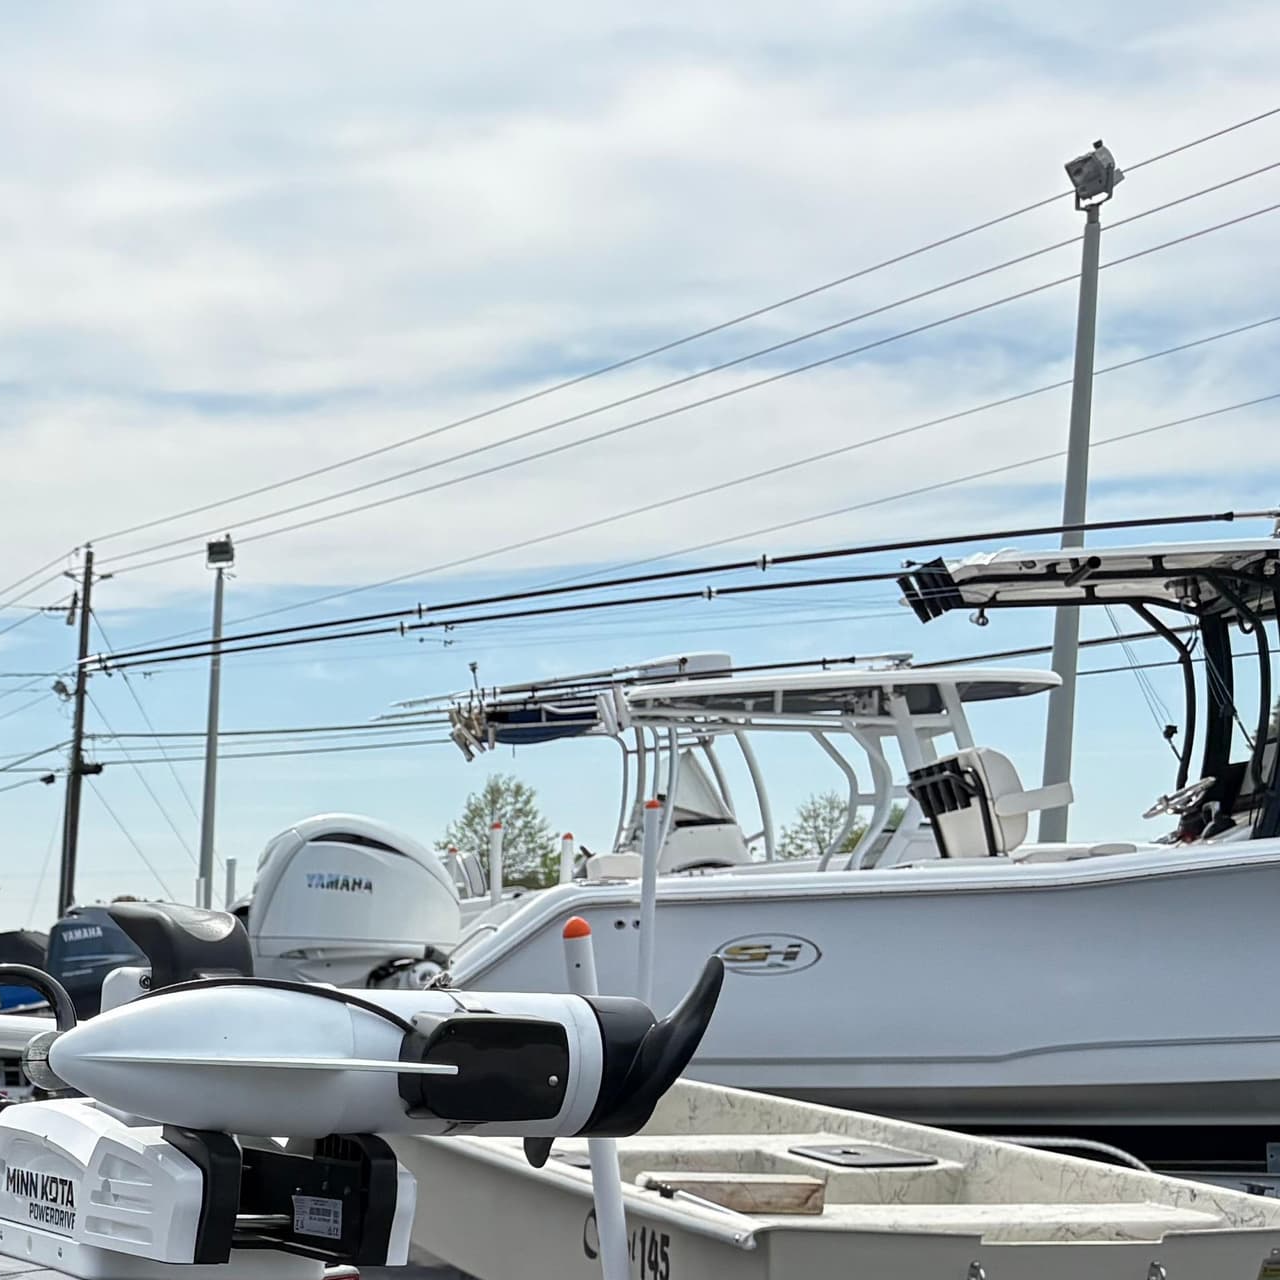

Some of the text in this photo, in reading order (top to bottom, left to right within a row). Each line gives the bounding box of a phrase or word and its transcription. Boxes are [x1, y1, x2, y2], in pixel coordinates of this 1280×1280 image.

[304, 873, 373, 896] YAMAHA
[62, 926, 103, 942] YAMAHA
[6, 1166, 75, 1209] MINN KOTA
